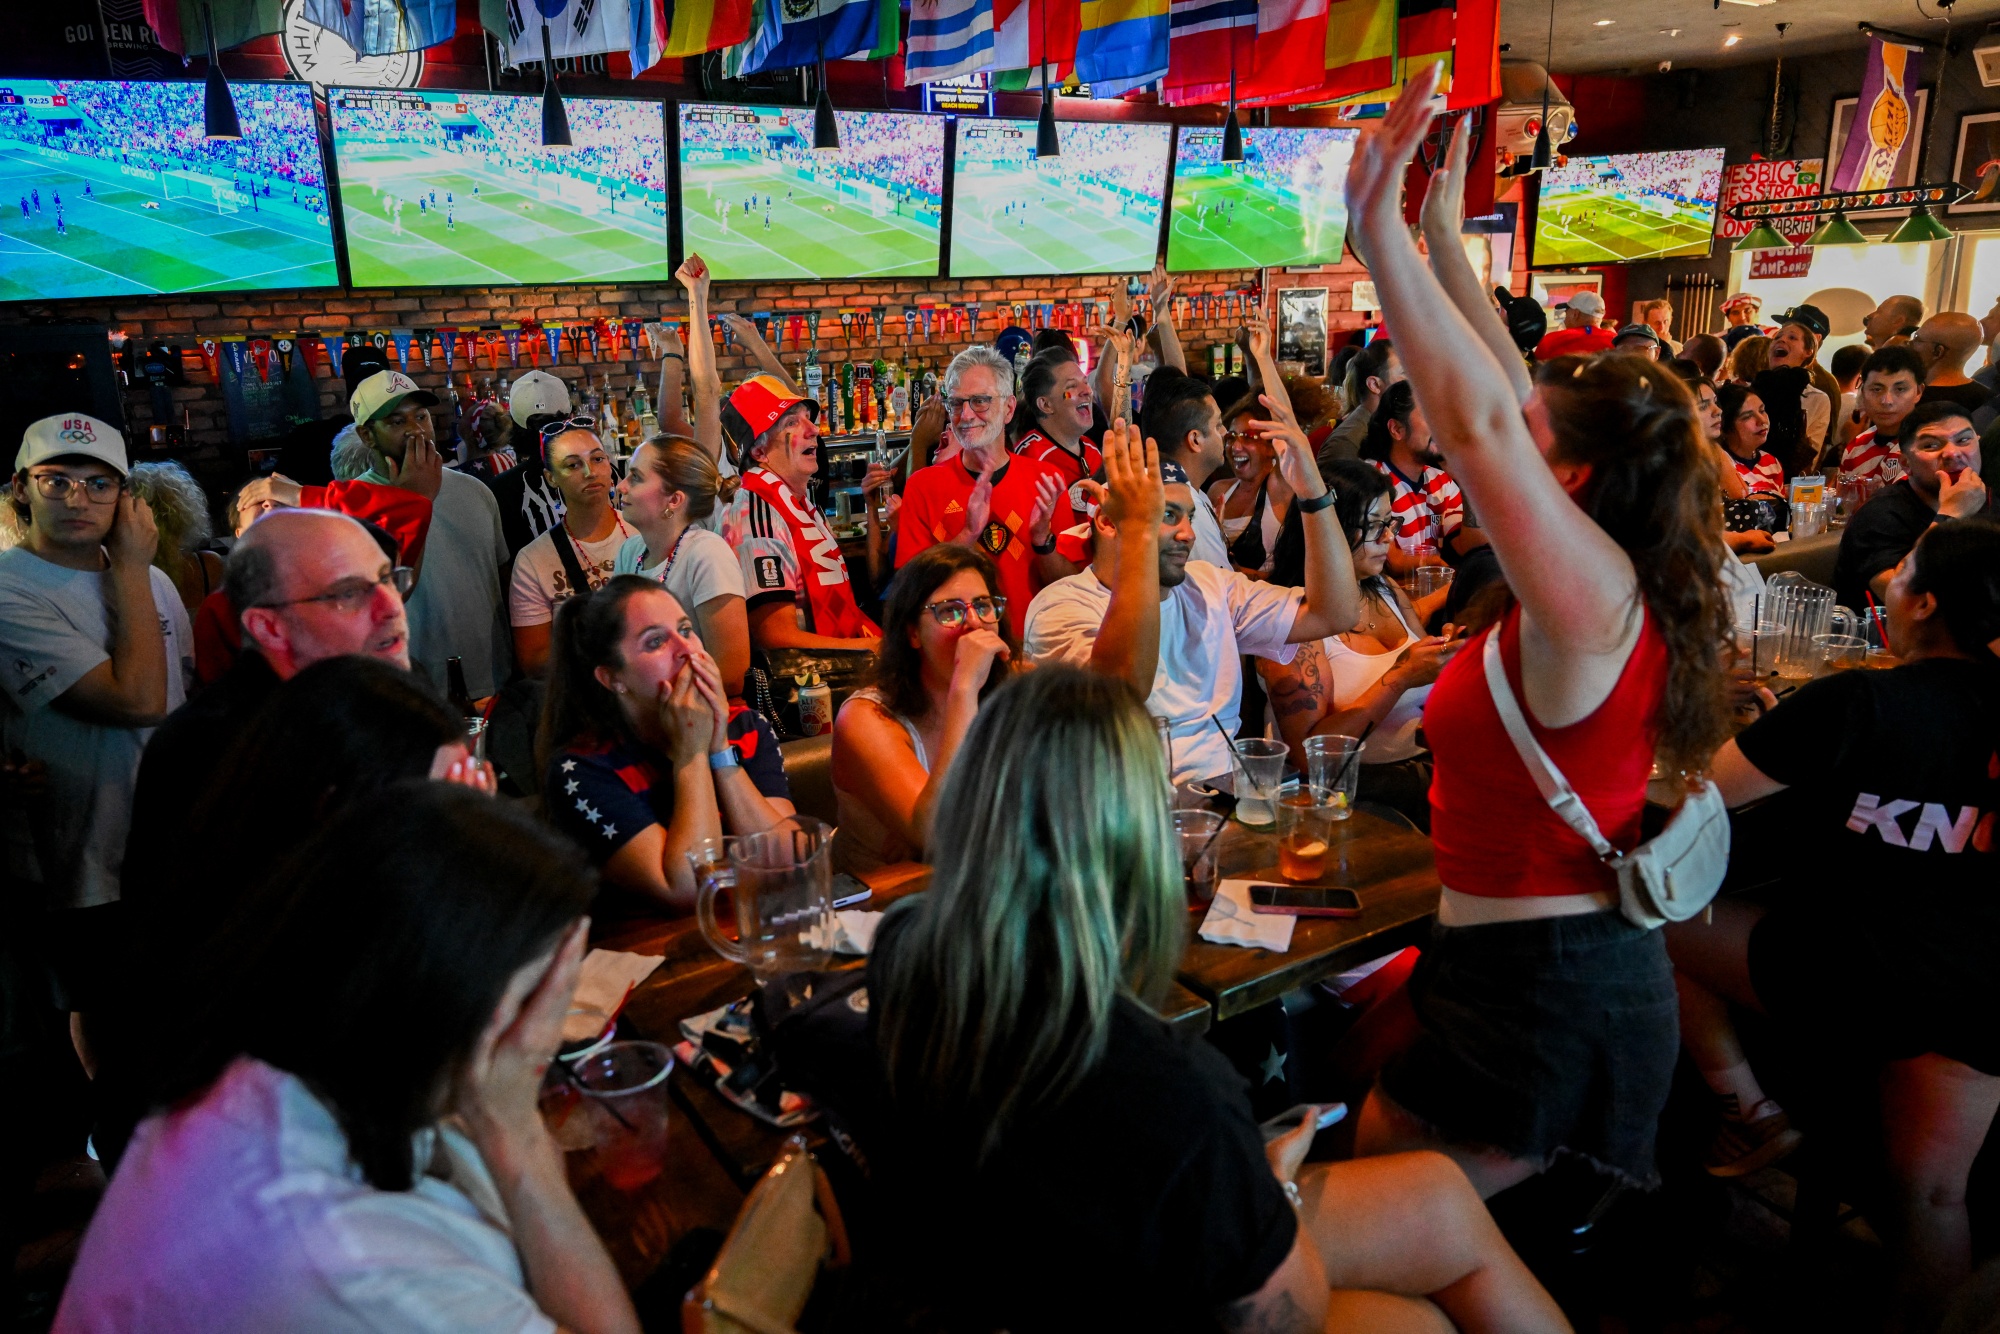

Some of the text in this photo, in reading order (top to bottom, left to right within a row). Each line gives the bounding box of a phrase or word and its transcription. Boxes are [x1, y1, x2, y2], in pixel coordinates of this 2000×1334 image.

[107, 42, 149, 50] BREWING
[38, 147, 69, 161] aramco
[121, 165, 156, 181] aramco
[1758, 160, 1797, 185] BIG
[211, 185, 249, 205] aramco
[1754, 182, 1821, 200] STRONG
[233, 351, 242, 373] RAMS
[423, 348, 431, 367] EAGLES
[858, 365, 871, 378] IPA
[63, 419, 93, 432] USA
